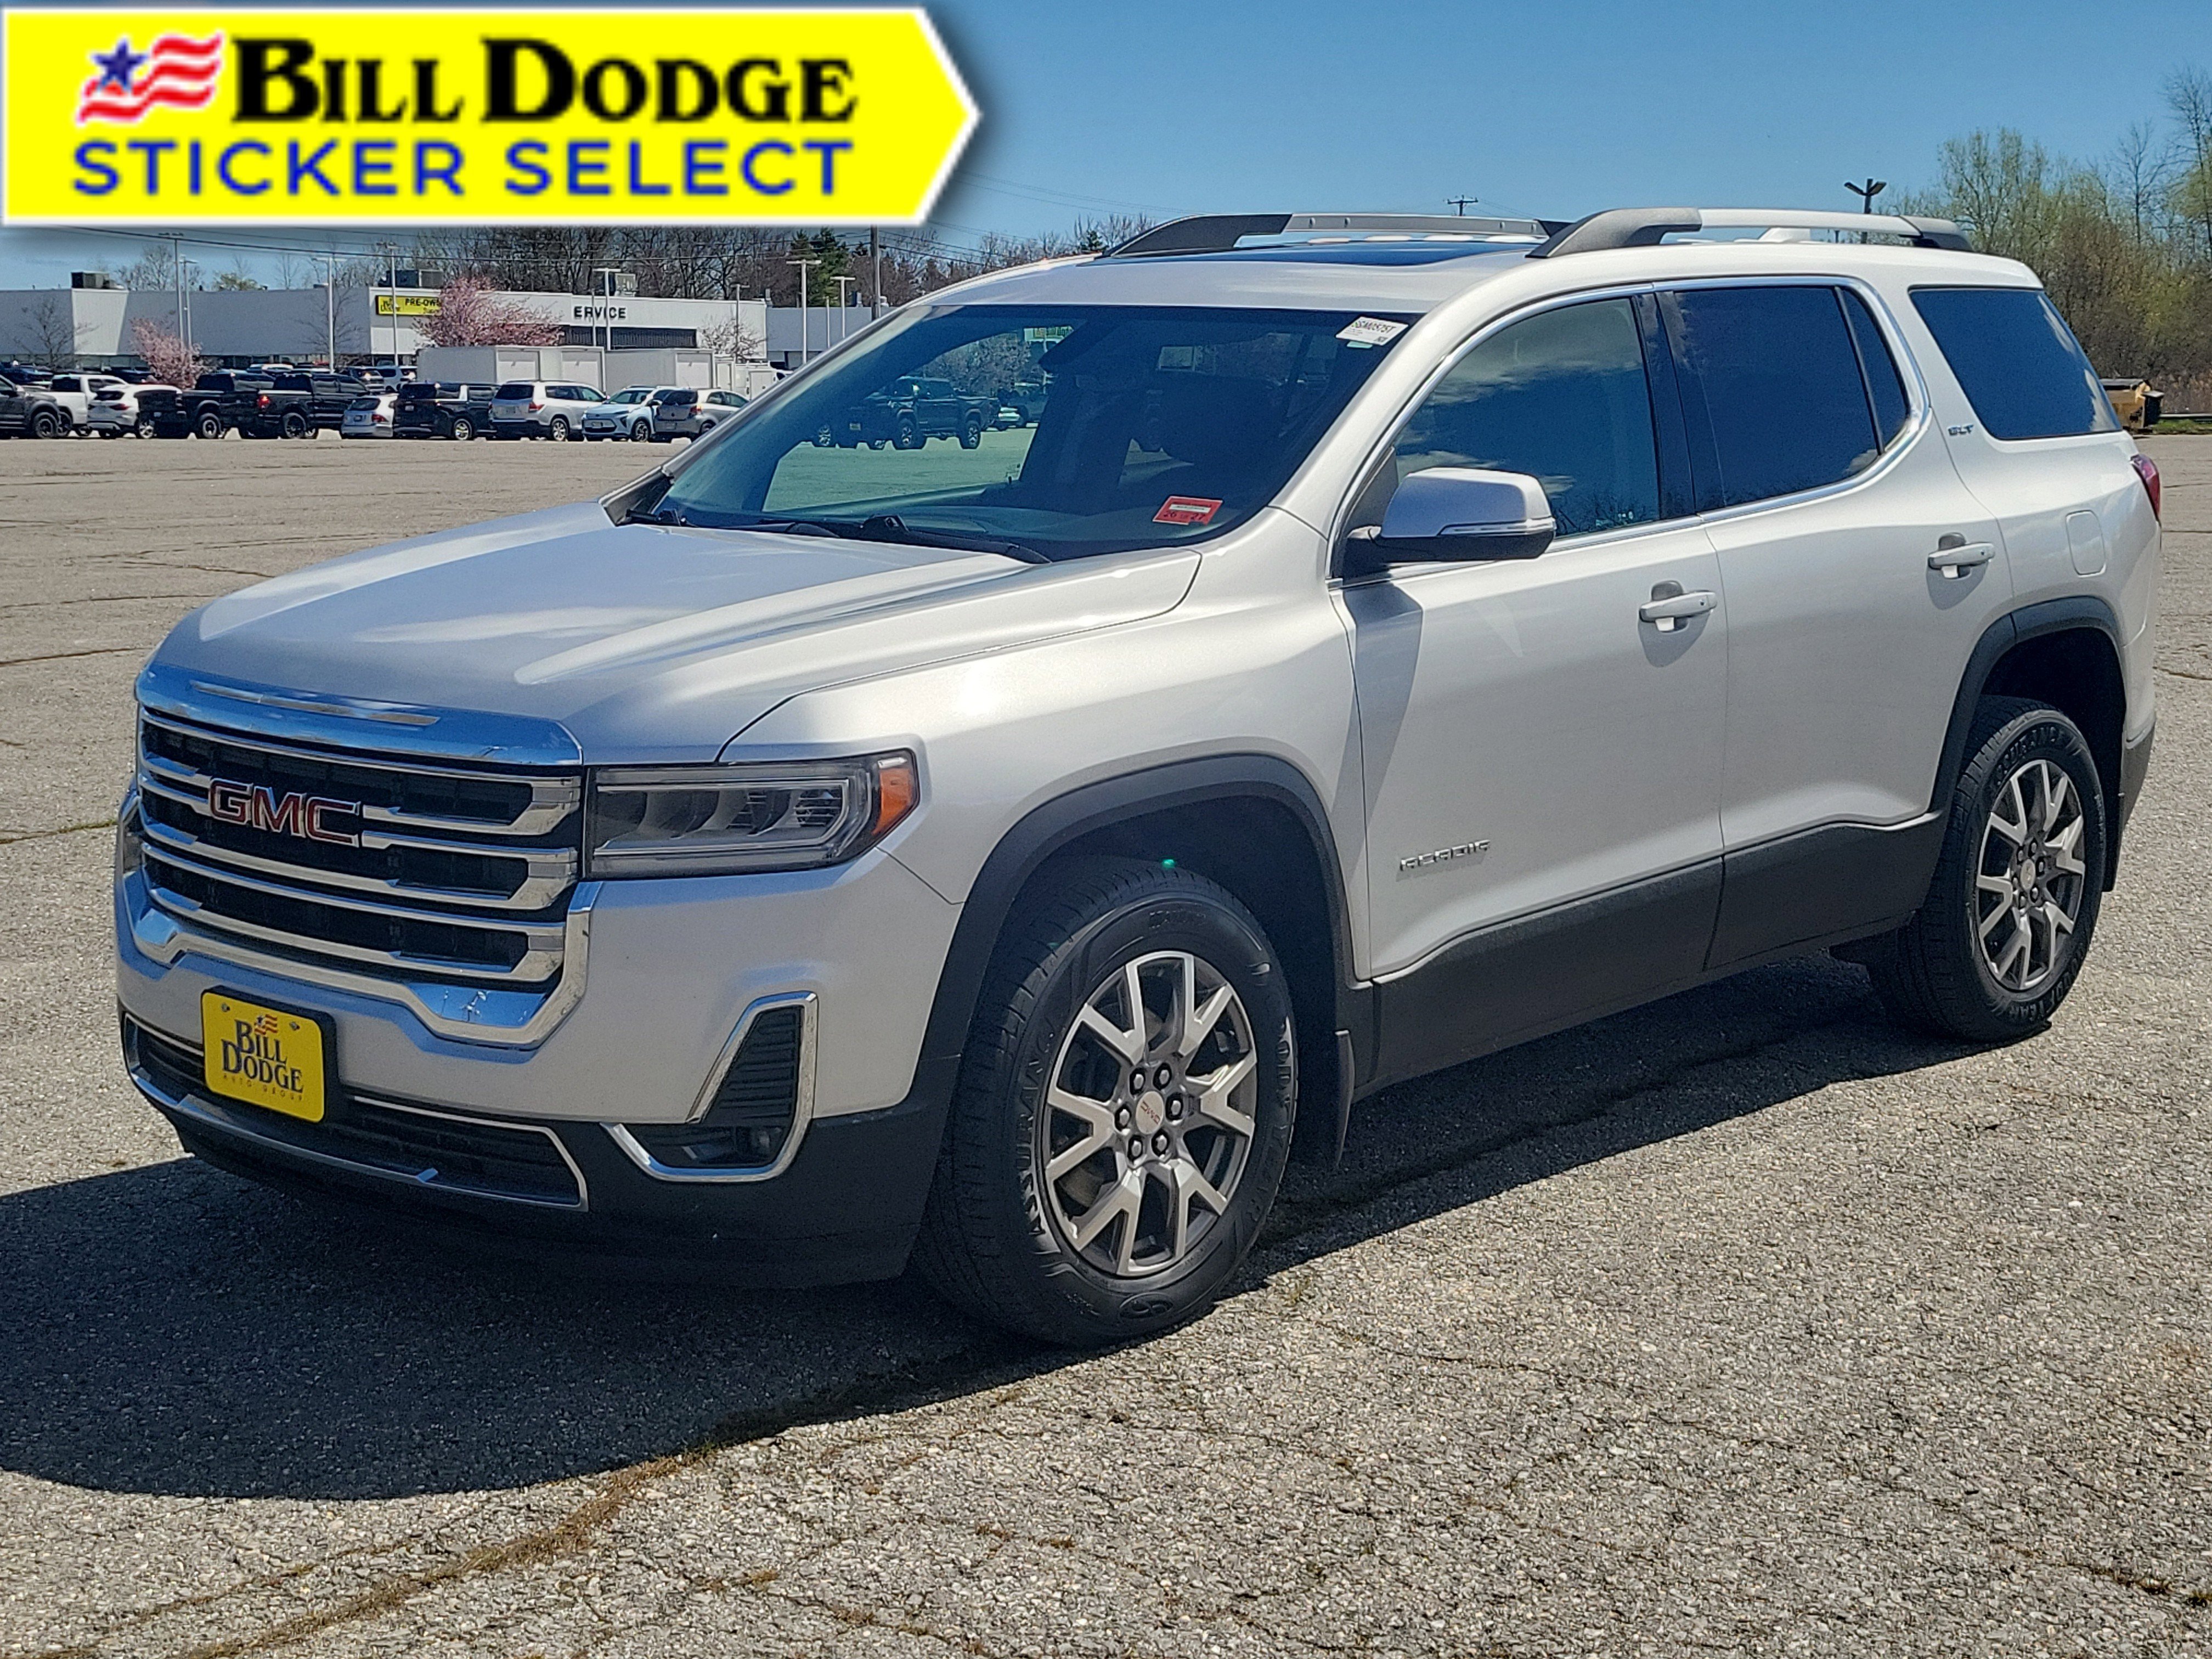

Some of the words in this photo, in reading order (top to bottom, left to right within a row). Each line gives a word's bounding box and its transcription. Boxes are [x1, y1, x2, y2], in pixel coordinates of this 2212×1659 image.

[208, 777, 361, 848] GMC
[221, 1039, 304, 1093] DODGE
[234, 1019, 287, 1064] BILL
